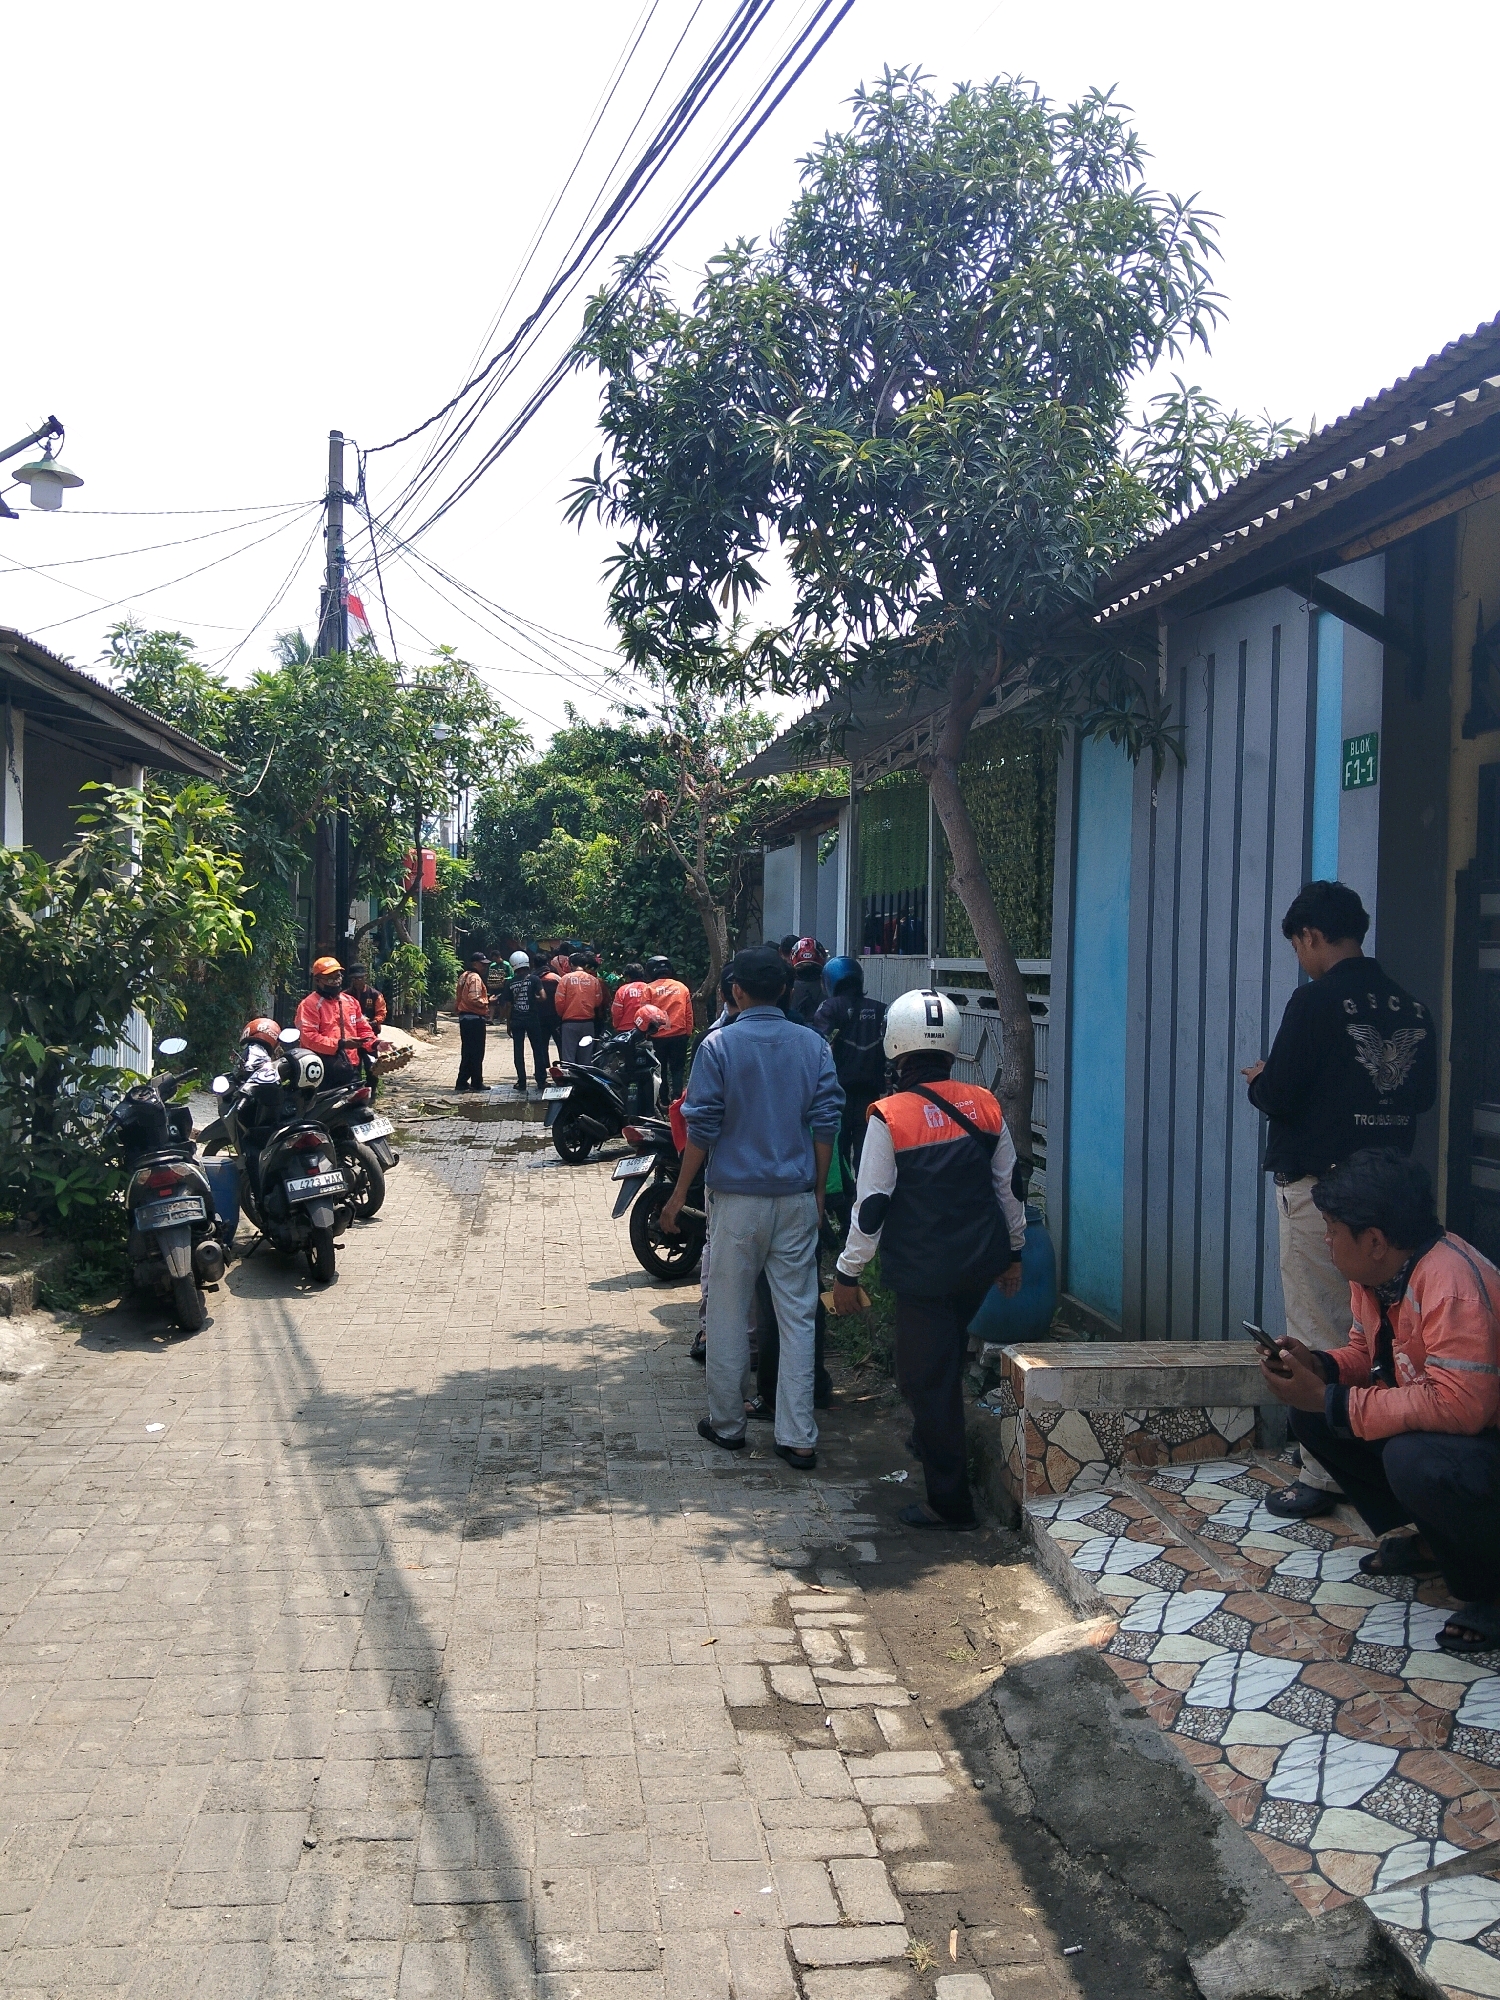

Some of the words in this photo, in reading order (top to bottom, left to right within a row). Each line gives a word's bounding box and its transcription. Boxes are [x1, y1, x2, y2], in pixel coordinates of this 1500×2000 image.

[1350, 738, 1371, 756] BLOK
[1345, 756, 1374, 786] F1-1
[289, 1182, 296, 1191] A
[324, 1173, 342, 1185] WAK
